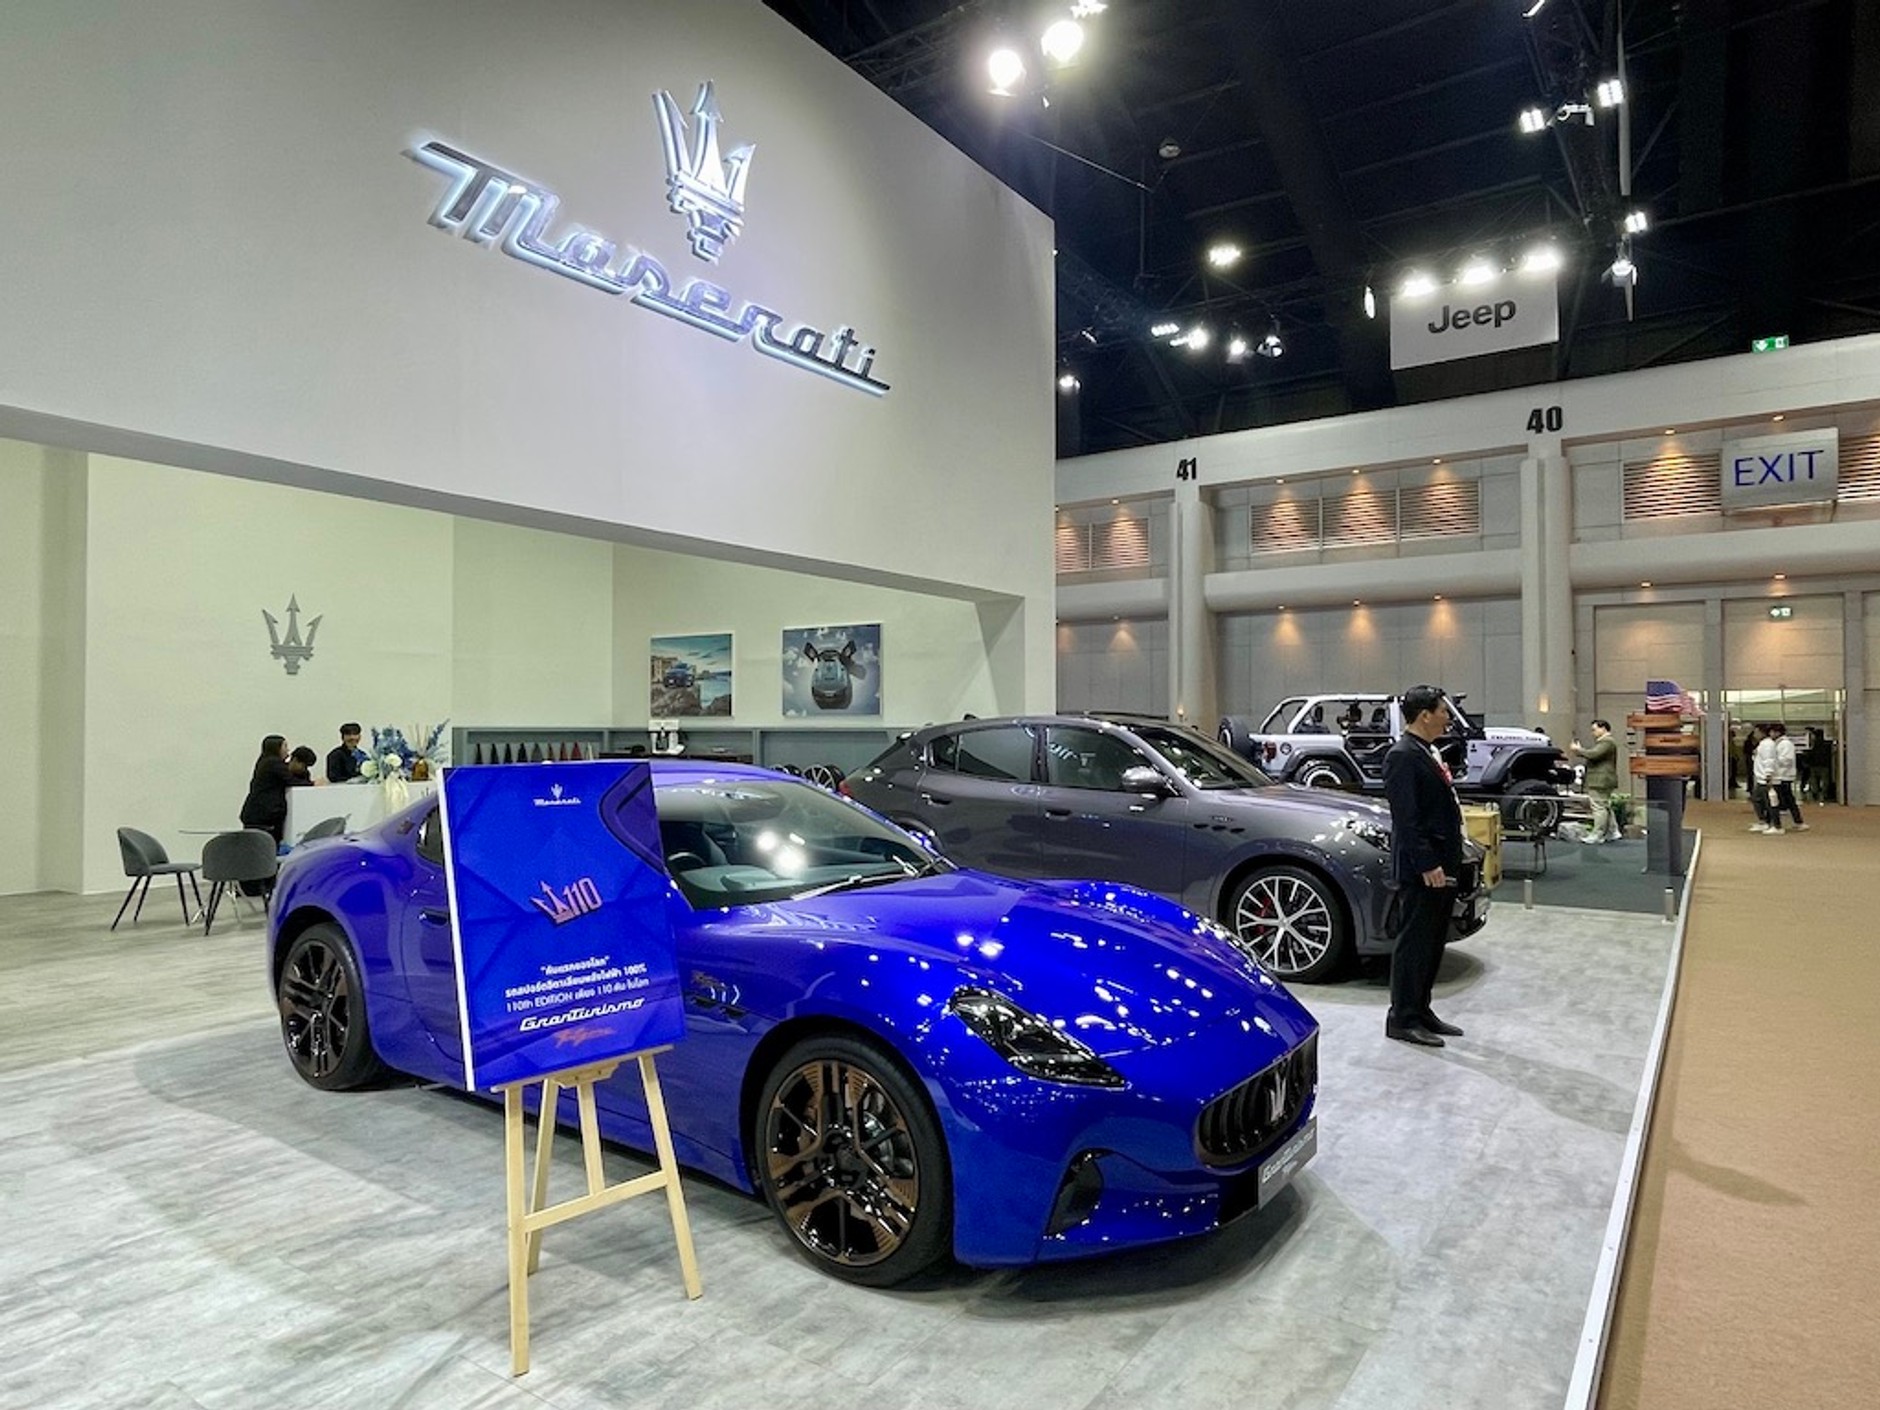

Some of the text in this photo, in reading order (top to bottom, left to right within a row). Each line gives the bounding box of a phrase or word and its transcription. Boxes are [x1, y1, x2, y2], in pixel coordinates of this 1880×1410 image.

[404, 139, 891, 397] Maserati
[1428, 300, 1516, 333] Jeep
[1527, 406, 1563, 434] 40
[1176, 457, 1196, 481] 41
[1735, 450, 1824, 486] EXIT
[563, 877, 602, 916] 110
[534, 991, 573, 1008] EDITION
[597, 983, 612, 996] 110
[520, 997, 645, 1031] GranTurismo
